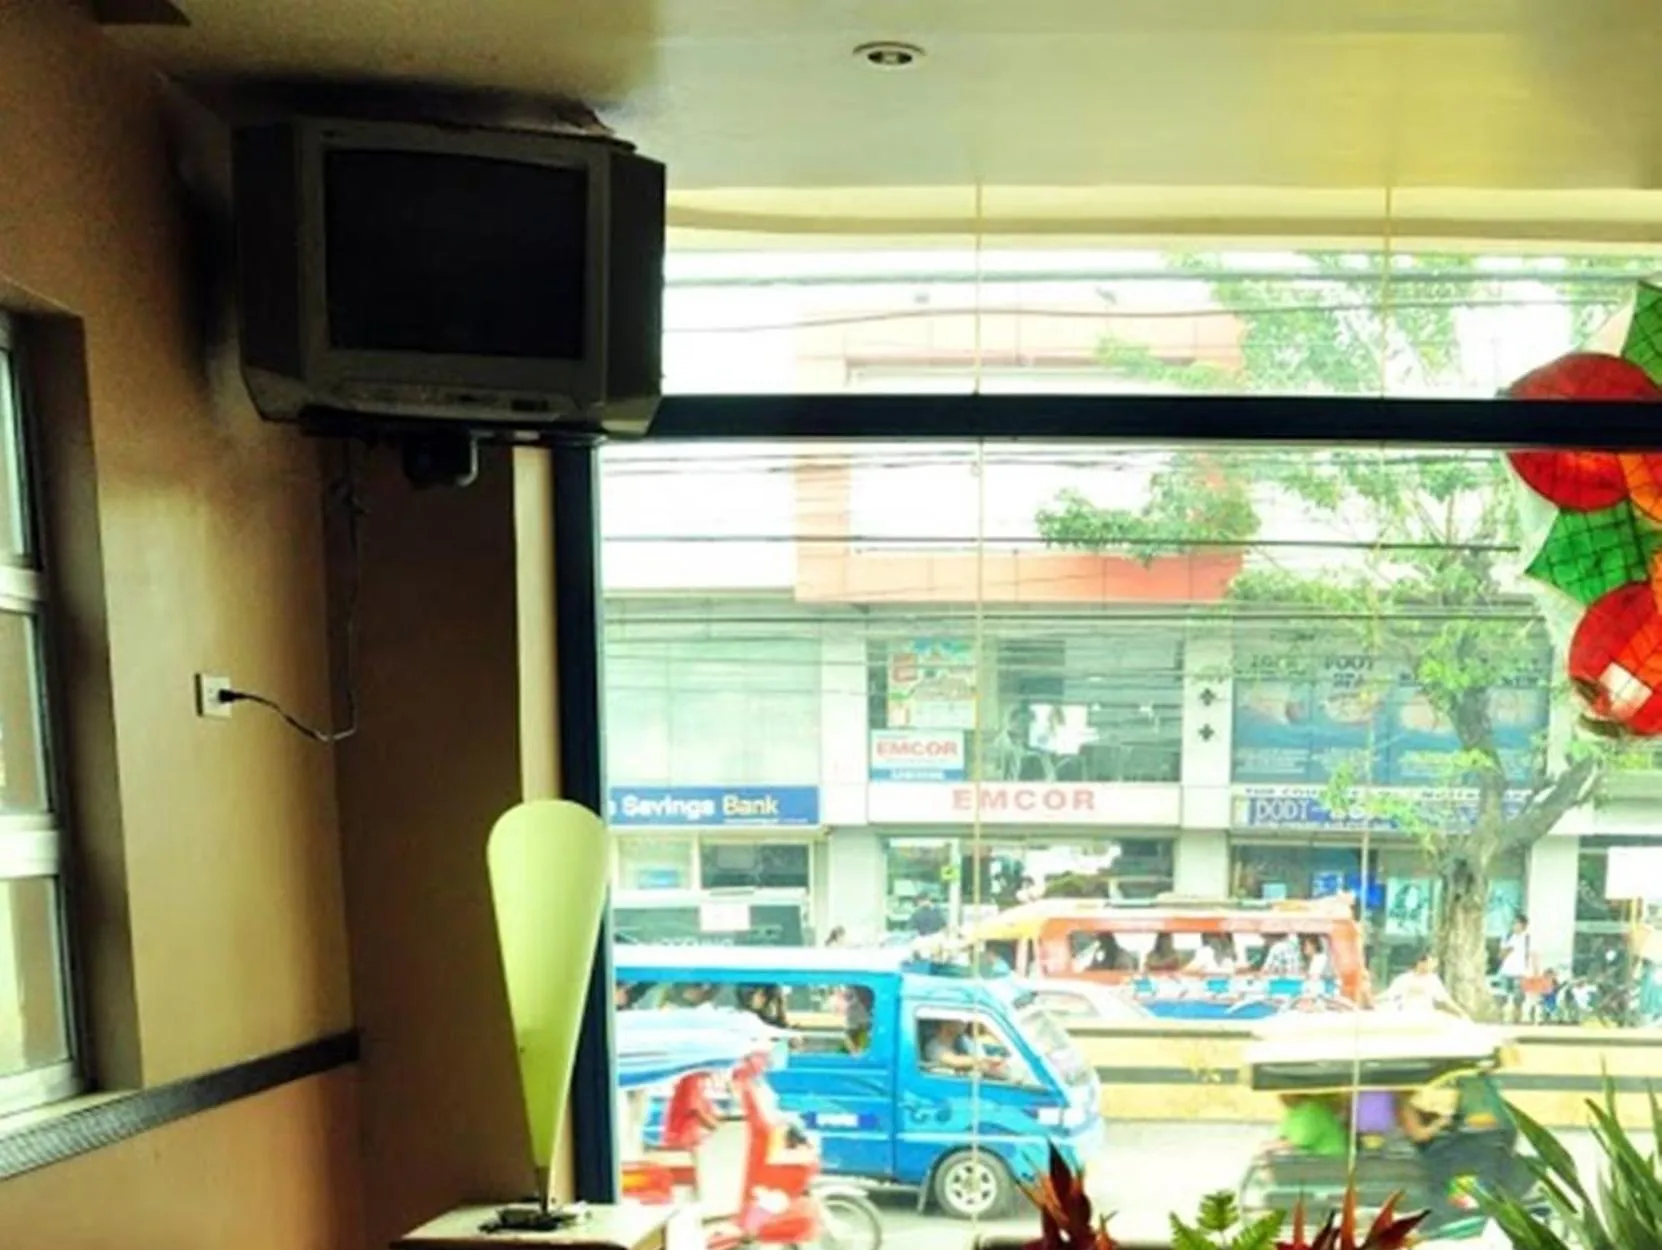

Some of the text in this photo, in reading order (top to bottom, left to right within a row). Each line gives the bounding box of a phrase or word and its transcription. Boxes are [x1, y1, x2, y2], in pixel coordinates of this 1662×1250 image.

[876, 740, 958, 758] EMCOR
[622, 794, 714, 819] Savings
[723, 794, 778, 816] Bank
[952, 788, 1095, 812] EMCOR
